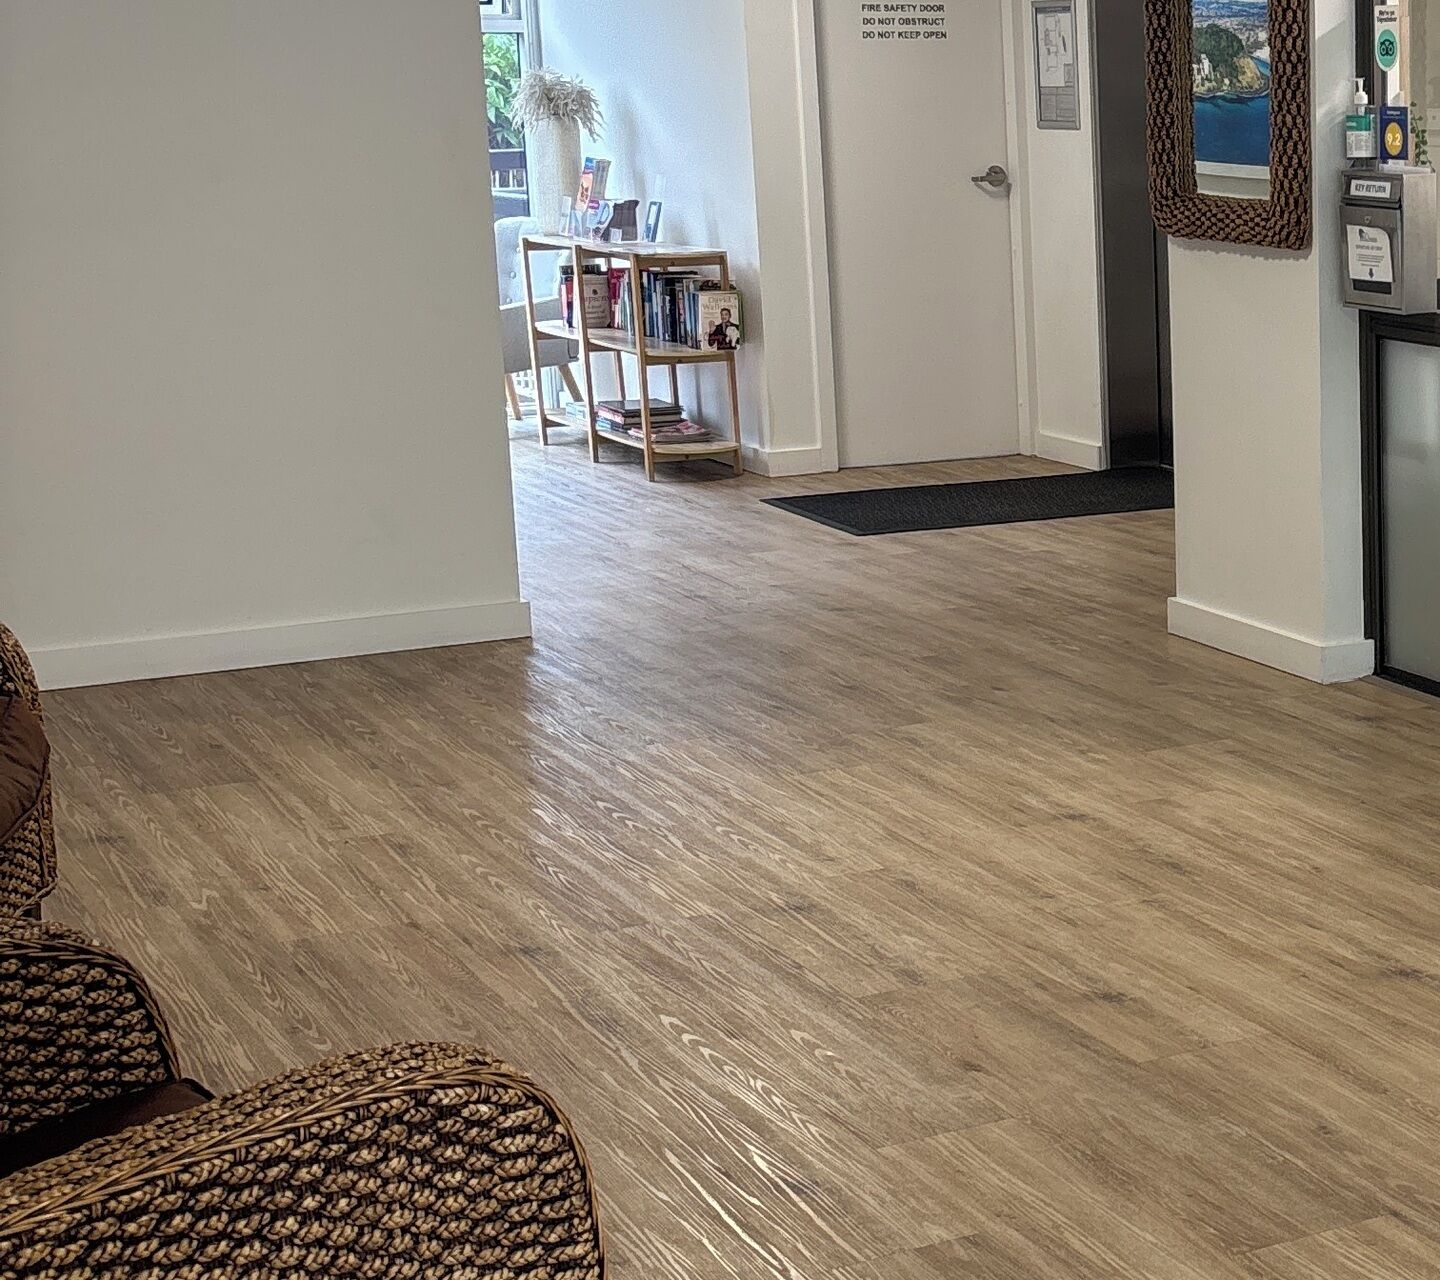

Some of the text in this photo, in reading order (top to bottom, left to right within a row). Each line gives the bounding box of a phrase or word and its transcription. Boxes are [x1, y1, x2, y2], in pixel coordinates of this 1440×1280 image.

[861, 3, 945, 13] FIRE SAFETY DOOR
[862, 17, 946, 26] DO NOT OBSTRUCT
[862, 30, 947, 40] DO NOT KEEP OPEN
[1386, 133, 1401, 146] 9.2
